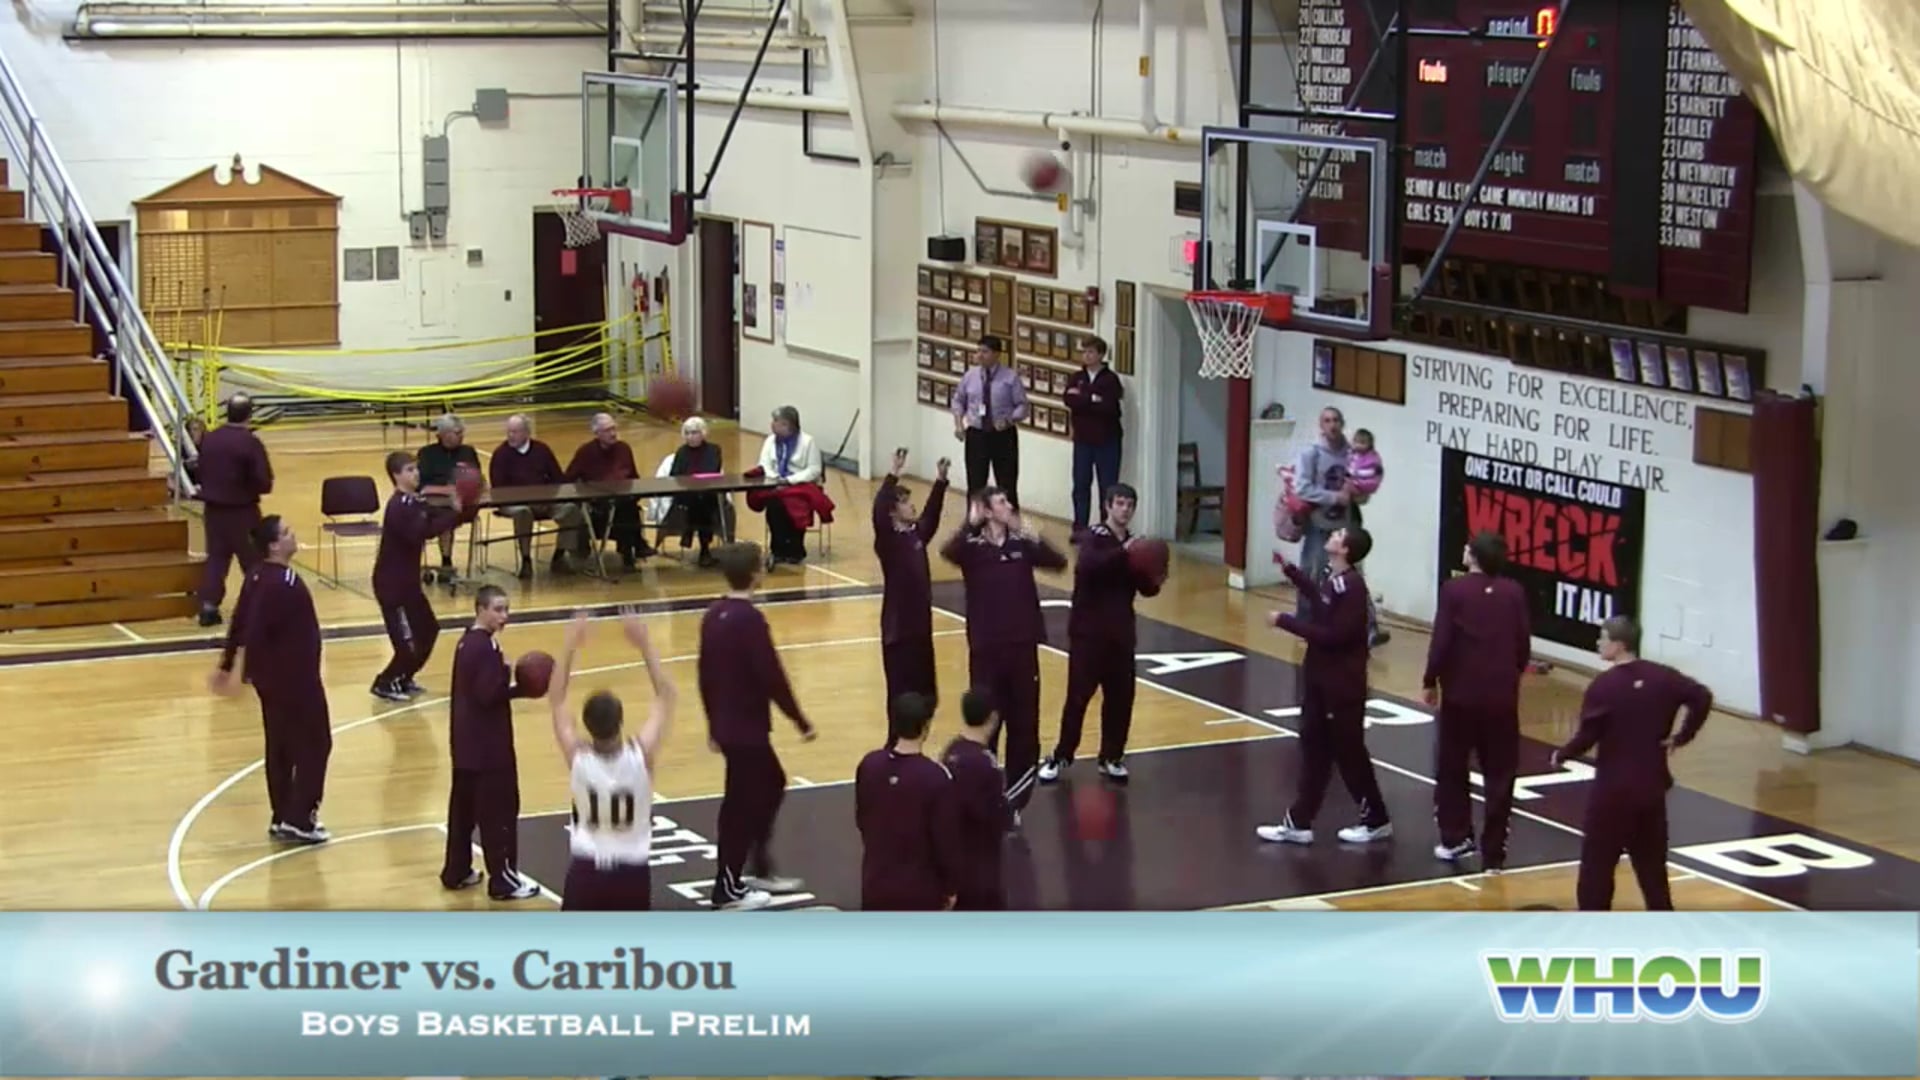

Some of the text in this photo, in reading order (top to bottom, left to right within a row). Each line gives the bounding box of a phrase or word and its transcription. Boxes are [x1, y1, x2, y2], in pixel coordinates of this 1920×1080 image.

[1668, 27, 1681, 48] 10
[1419, 58, 1447, 82] fouls
[1667, 50, 1679, 70] 11
[1487, 61, 1528, 87] player
[1570, 67, 1602, 91] fouls
[1665, 72, 1678, 92] 12
[1664, 94, 1678, 114] 15
[1664, 116, 1713, 139] 21 BAILEY
[1414, 147, 1447, 169] match
[1662, 138, 1704, 161] 23 LAMB
[1486, 152, 1525, 177] eight
[1564, 161, 1600, 183] match
[1661, 160, 1737, 187] 24 WEYMOUTH
[1405, 177, 1434, 198] SENIOR
[1437, 181, 1452, 200] ALL
[1480, 185, 1504, 206] GAME
[1508, 187, 1546, 210] MONDAY
[1546, 191, 1579, 214] MARCH
[1581, 196, 1595, 216] 10
[1660, 182, 1731, 209] 30 MCKELVEY
[1406, 202, 1430, 222] GIRLS
[1464, 209, 1488, 229] BOYS
[1660, 204, 1674, 224] 32
[1659, 226, 1674, 245] 33
[1412, 355, 1693, 430] STRIVING FOR EXCELLENCE,
[1438, 391, 1660, 456] PREPARING FOR LIFE.
[1426, 420, 1471, 450] PLAY
[1554, 447, 1602, 481] PLAY
[1619, 460, 1670, 493] FAIR.
[1464, 455, 1621, 508] ONE TEXT OR CALL COULD
[1464, 484, 1621, 587] WRECK
[1555, 581, 1613, 626] IT ALL
[587, 785, 636, 828] 10
